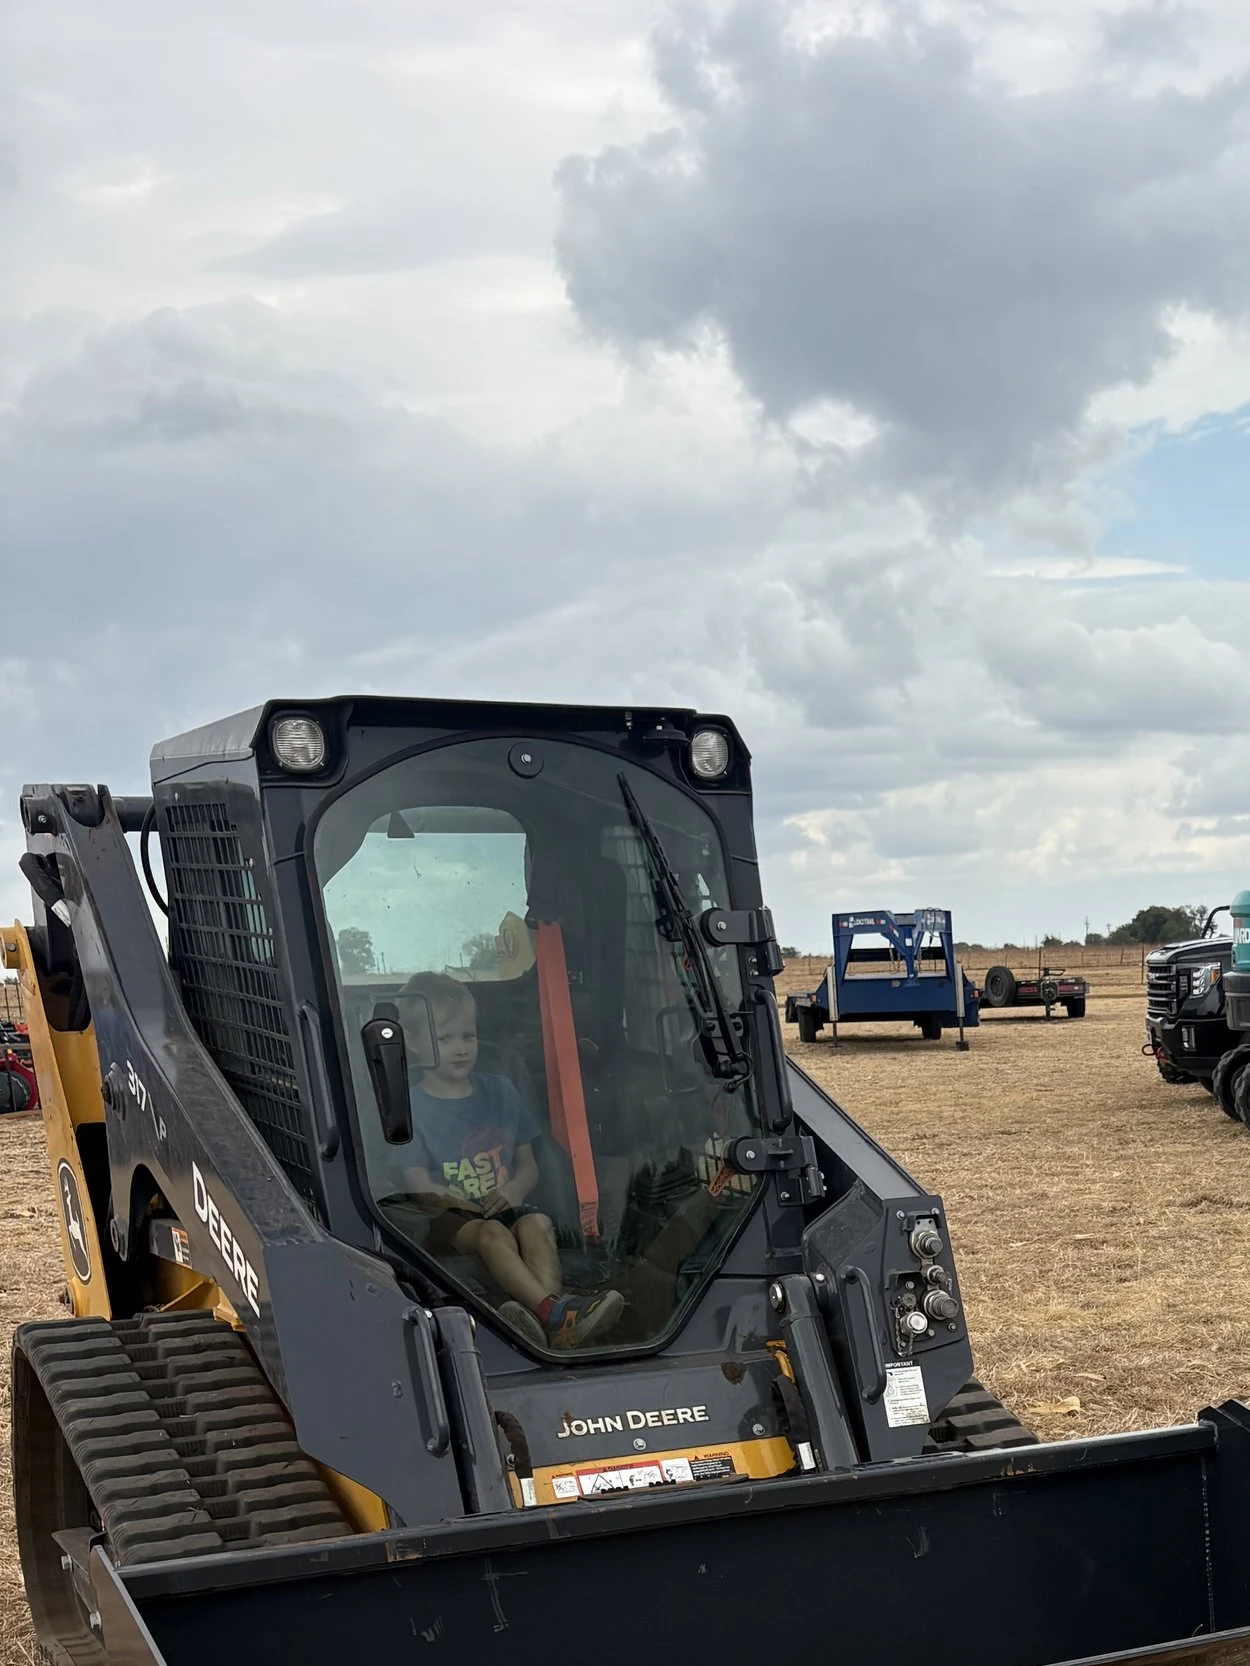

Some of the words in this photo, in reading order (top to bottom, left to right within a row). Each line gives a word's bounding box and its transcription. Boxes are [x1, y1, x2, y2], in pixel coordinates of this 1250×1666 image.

[126, 1059, 147, 1112] 317
[443, 1147, 503, 1181] FAST
[192, 1160, 261, 1319] DEERE
[557, 1415, 624, 1439] JOHN
[626, 1405, 710, 1431] DEERE
